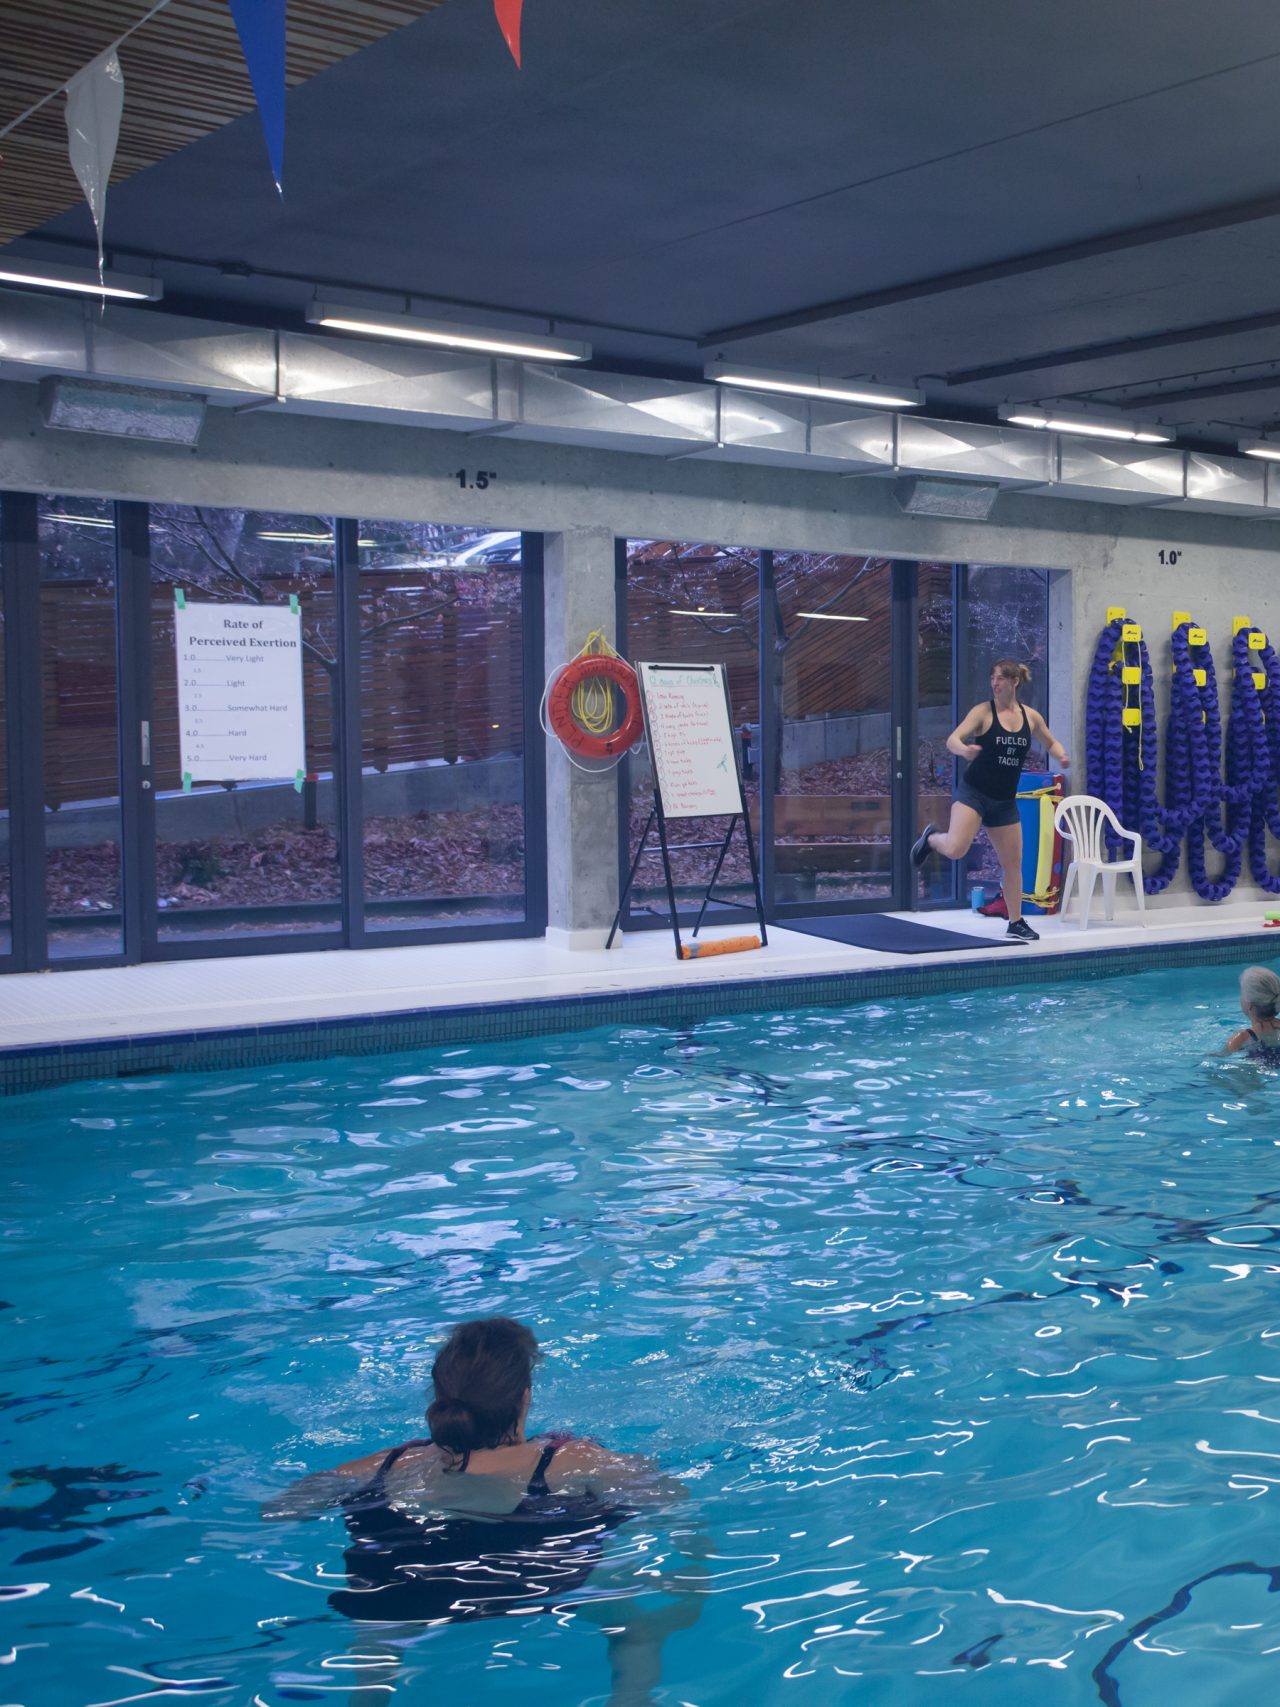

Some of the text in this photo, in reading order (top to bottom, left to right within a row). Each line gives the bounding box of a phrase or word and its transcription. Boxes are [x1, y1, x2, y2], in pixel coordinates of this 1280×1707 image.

[223, 619, 264, 629] Rate of
[189, 636, 297, 648] Perceived Exertion
[225, 655, 244, 663] Very
[245, 655, 264, 663] Light
[226, 679, 246, 688] Light
[227, 704, 268, 712] Somewhat
[269, 704, 288, 712] Hard
[228, 729, 247, 737] Hard
[996, 736, 1027, 746] FUELED
[1006, 747, 1016, 755] BY
[228, 754, 246, 763] Very
[998, 756, 1020, 767] TACOS
